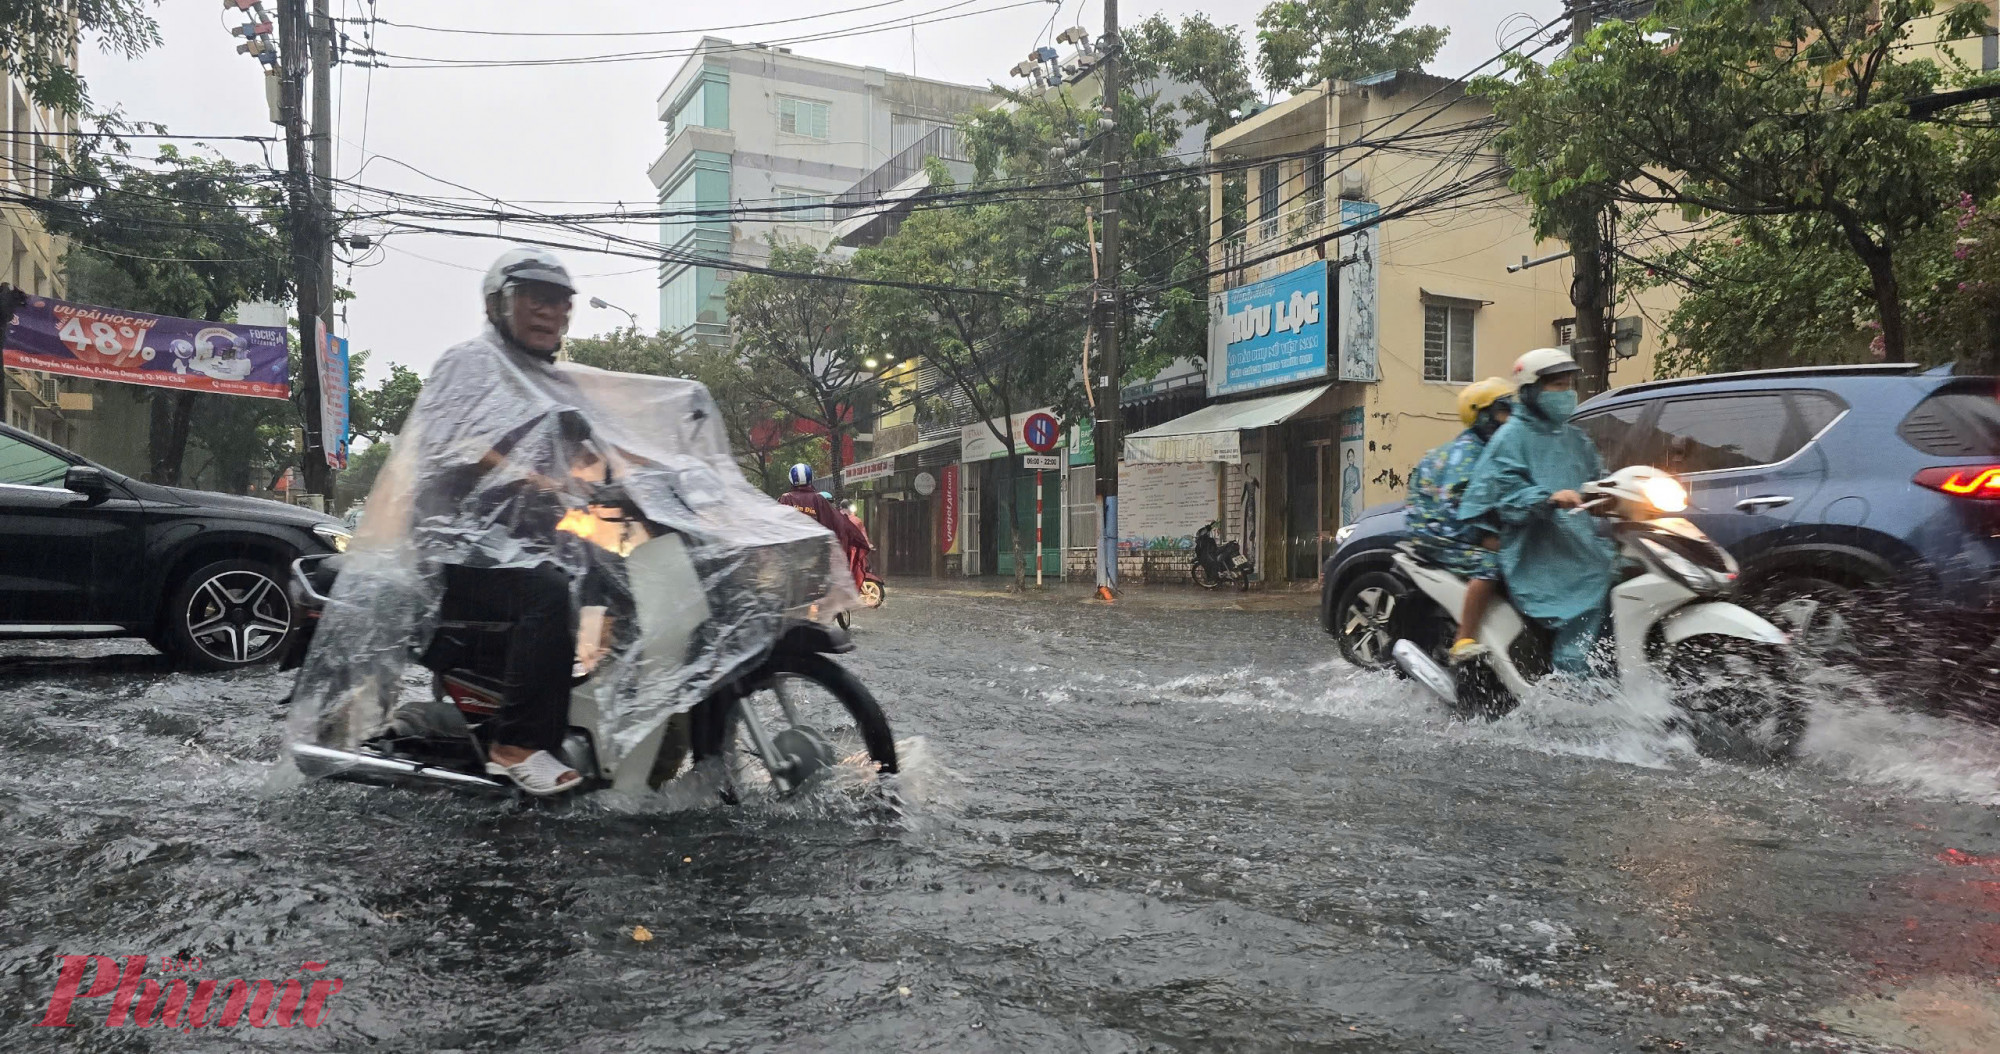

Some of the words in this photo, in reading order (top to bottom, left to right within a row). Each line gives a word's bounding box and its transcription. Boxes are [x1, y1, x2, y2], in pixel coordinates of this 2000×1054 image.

[58, 317, 156, 361] 48%
[249, 329, 277, 341] FOCUS
[1227, 303, 1273, 345] HỮU
[1275, 290, 1320, 334] LỘC
